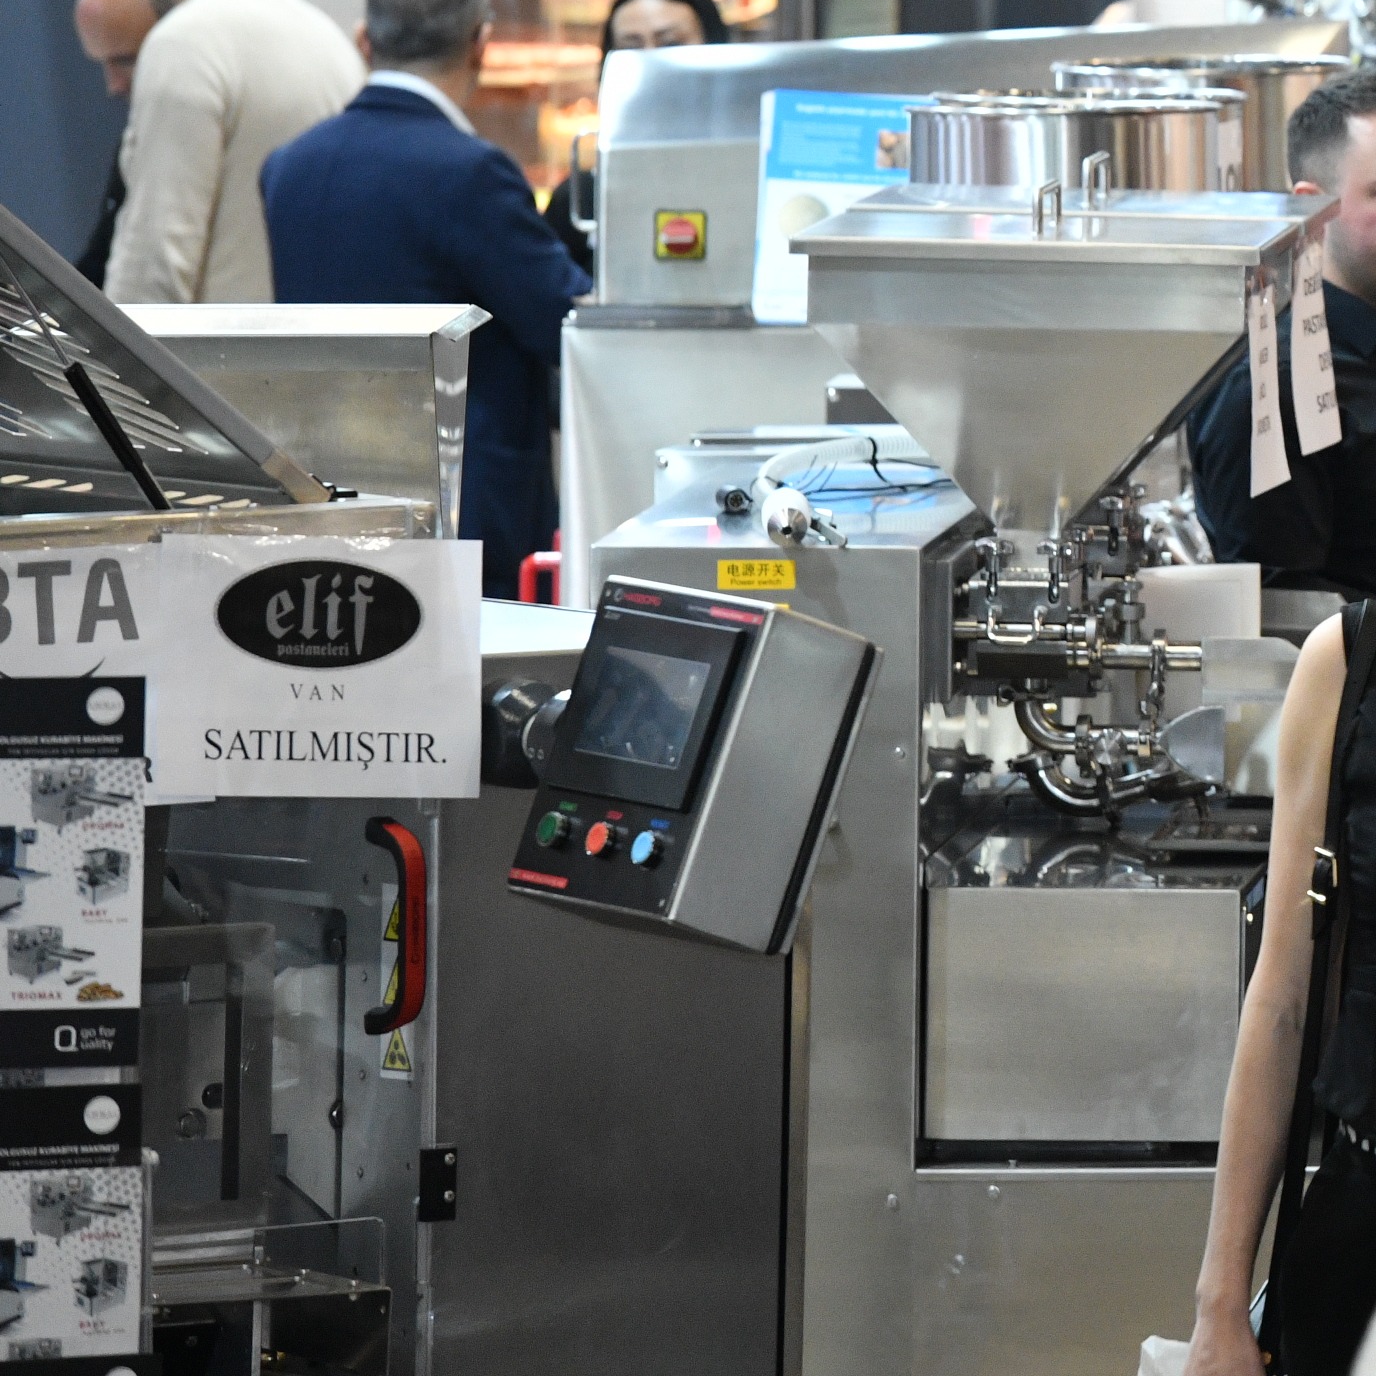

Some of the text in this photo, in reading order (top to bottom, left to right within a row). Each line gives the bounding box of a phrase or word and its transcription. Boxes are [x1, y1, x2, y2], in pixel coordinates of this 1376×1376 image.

[726, 562, 785, 577] 电源开关
[729, 577, 782, 586] Power switch
[0, 558, 140, 646] TA
[265, 572, 375, 656] elif
[276, 640, 349, 657] pastaneleri
[290, 683, 345, 701] VAN
[203, 728, 448, 771] SATILMIŞTIR.
